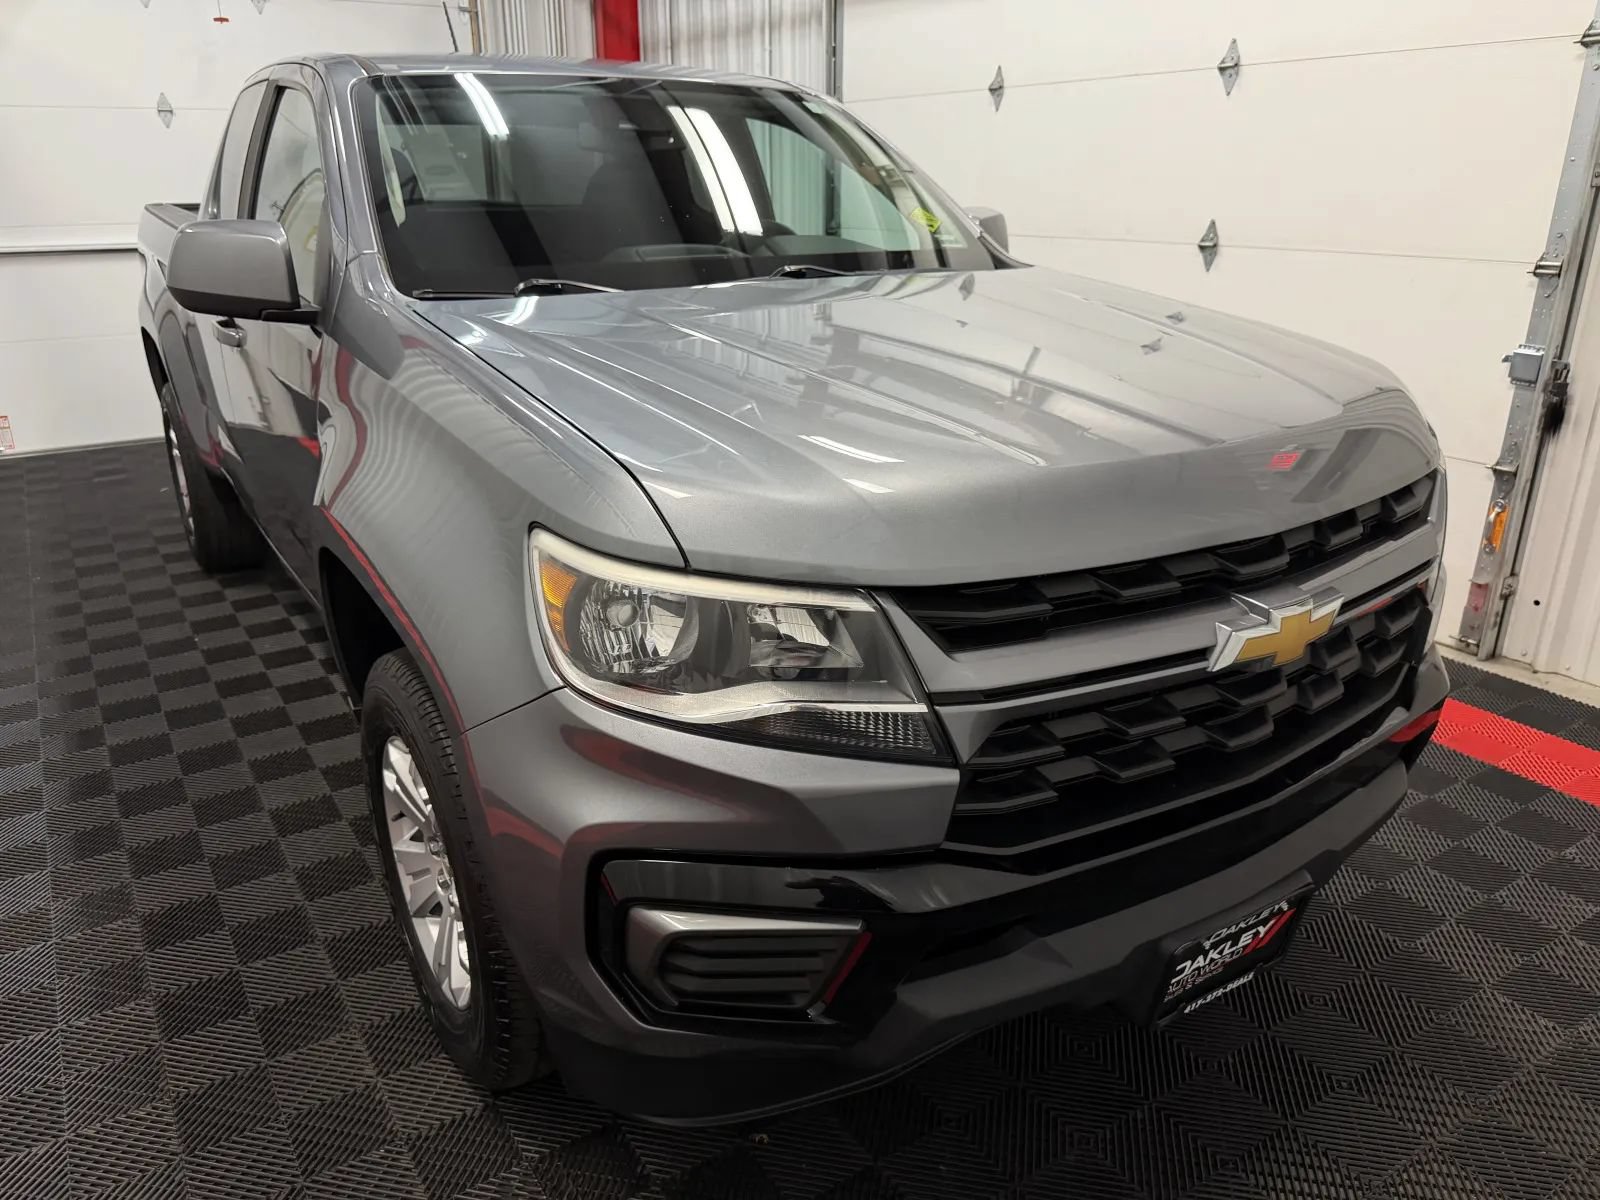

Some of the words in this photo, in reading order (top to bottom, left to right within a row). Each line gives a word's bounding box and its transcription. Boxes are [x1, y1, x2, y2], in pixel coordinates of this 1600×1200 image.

[1209, 900, 1286, 943] OAKLEY
[1166, 970, 1198, 993] AUTO
[1200, 947, 1244, 976] WORLD
